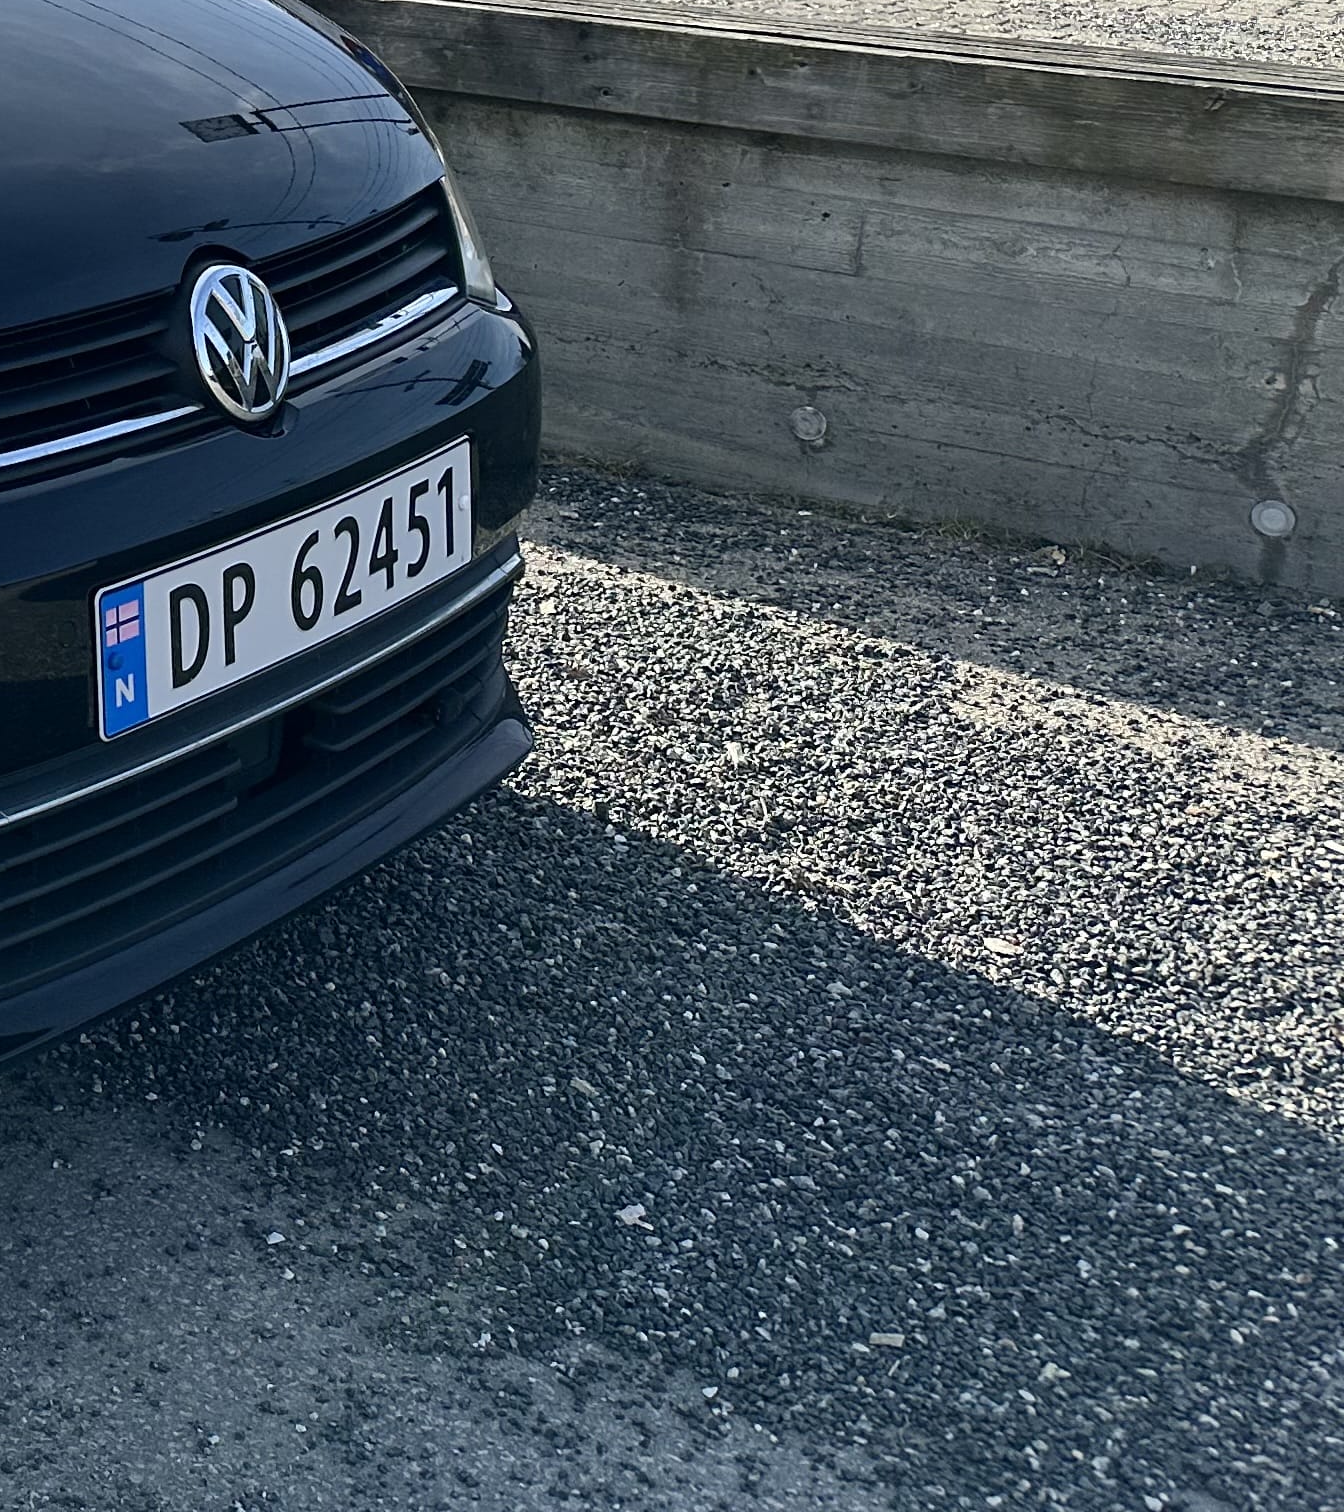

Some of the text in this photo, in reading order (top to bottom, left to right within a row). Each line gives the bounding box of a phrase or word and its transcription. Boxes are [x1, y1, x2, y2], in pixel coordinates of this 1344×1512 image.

[169, 465, 455, 689] DP 62451
[115, 672, 135, 707] N
